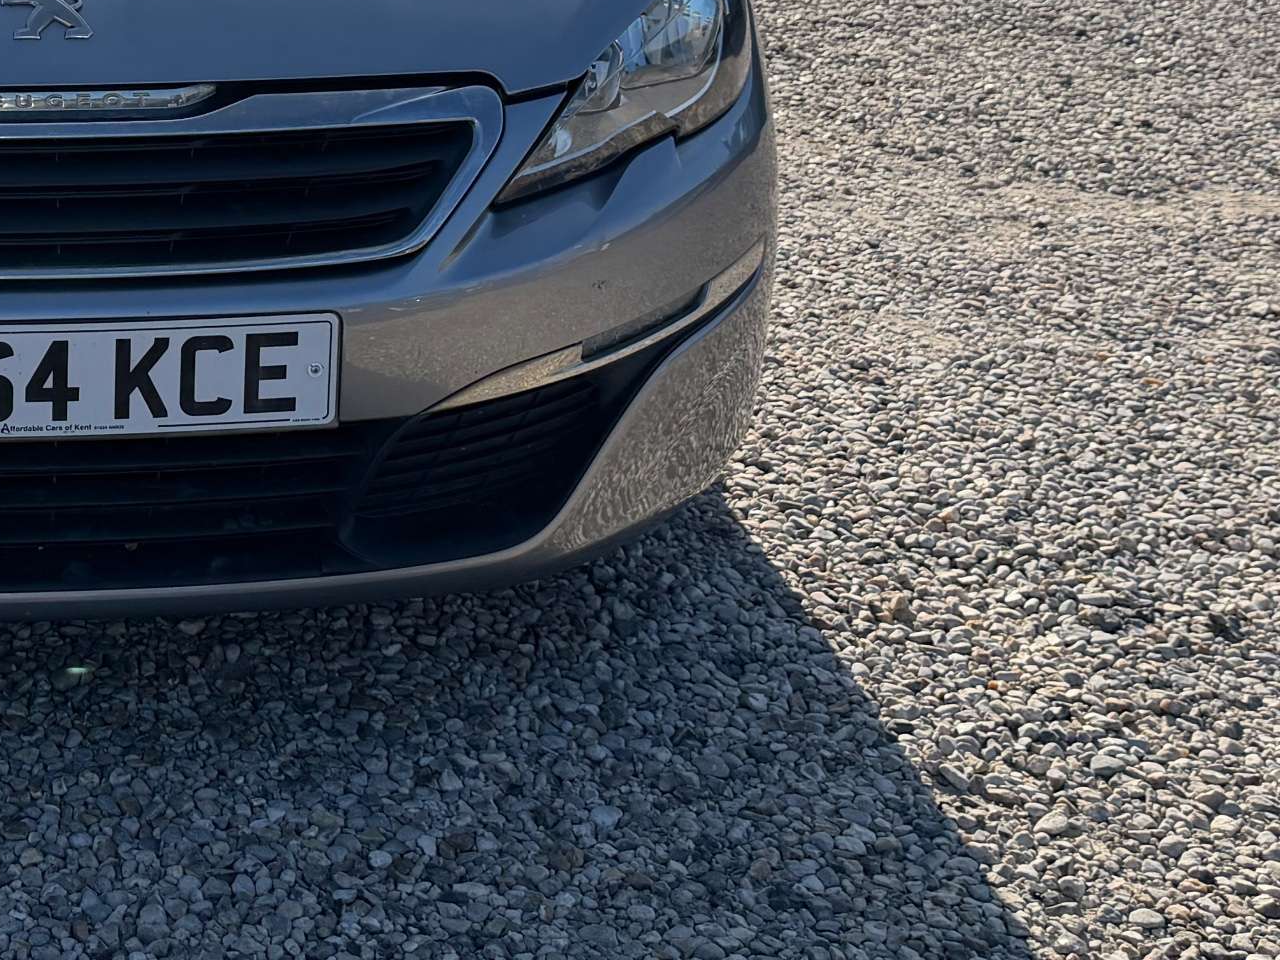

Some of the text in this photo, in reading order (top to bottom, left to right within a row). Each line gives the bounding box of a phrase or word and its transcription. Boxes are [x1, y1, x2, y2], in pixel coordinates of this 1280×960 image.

[114, 331, 300, 420] KCE
[0, 423, 44, 434] Affordable
[45, 424, 63, 432] Cars
[74, 423, 92, 431] Kent
